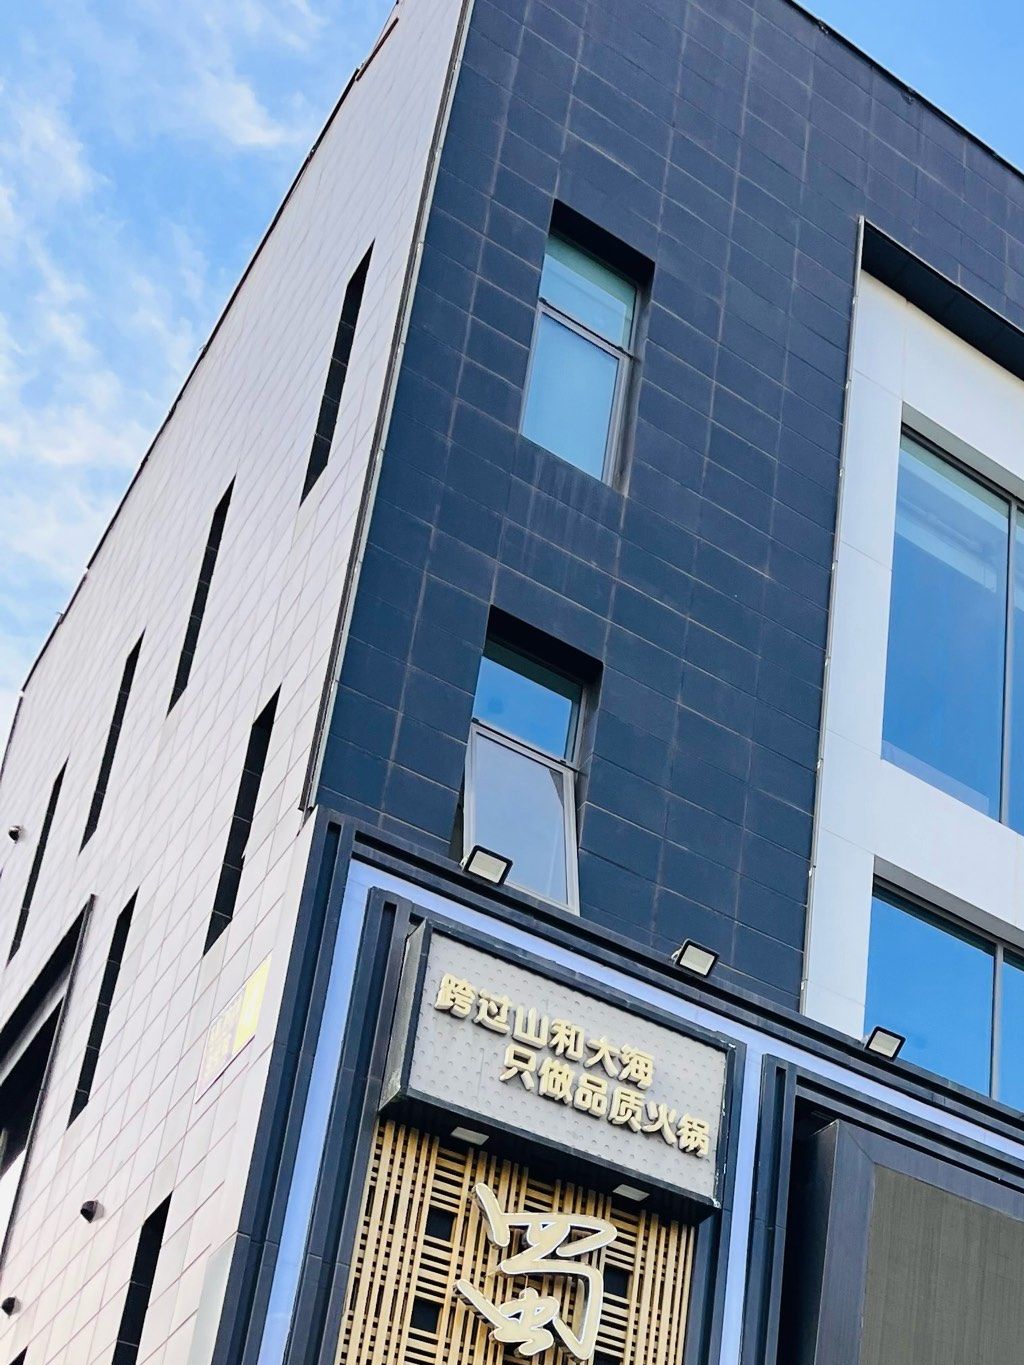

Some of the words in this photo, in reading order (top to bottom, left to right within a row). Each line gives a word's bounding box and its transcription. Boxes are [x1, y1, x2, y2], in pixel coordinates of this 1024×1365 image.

[434, 973, 655, 1090] 跨过山和大海
[499, 1043, 710, 1158] 只做品质火锅
